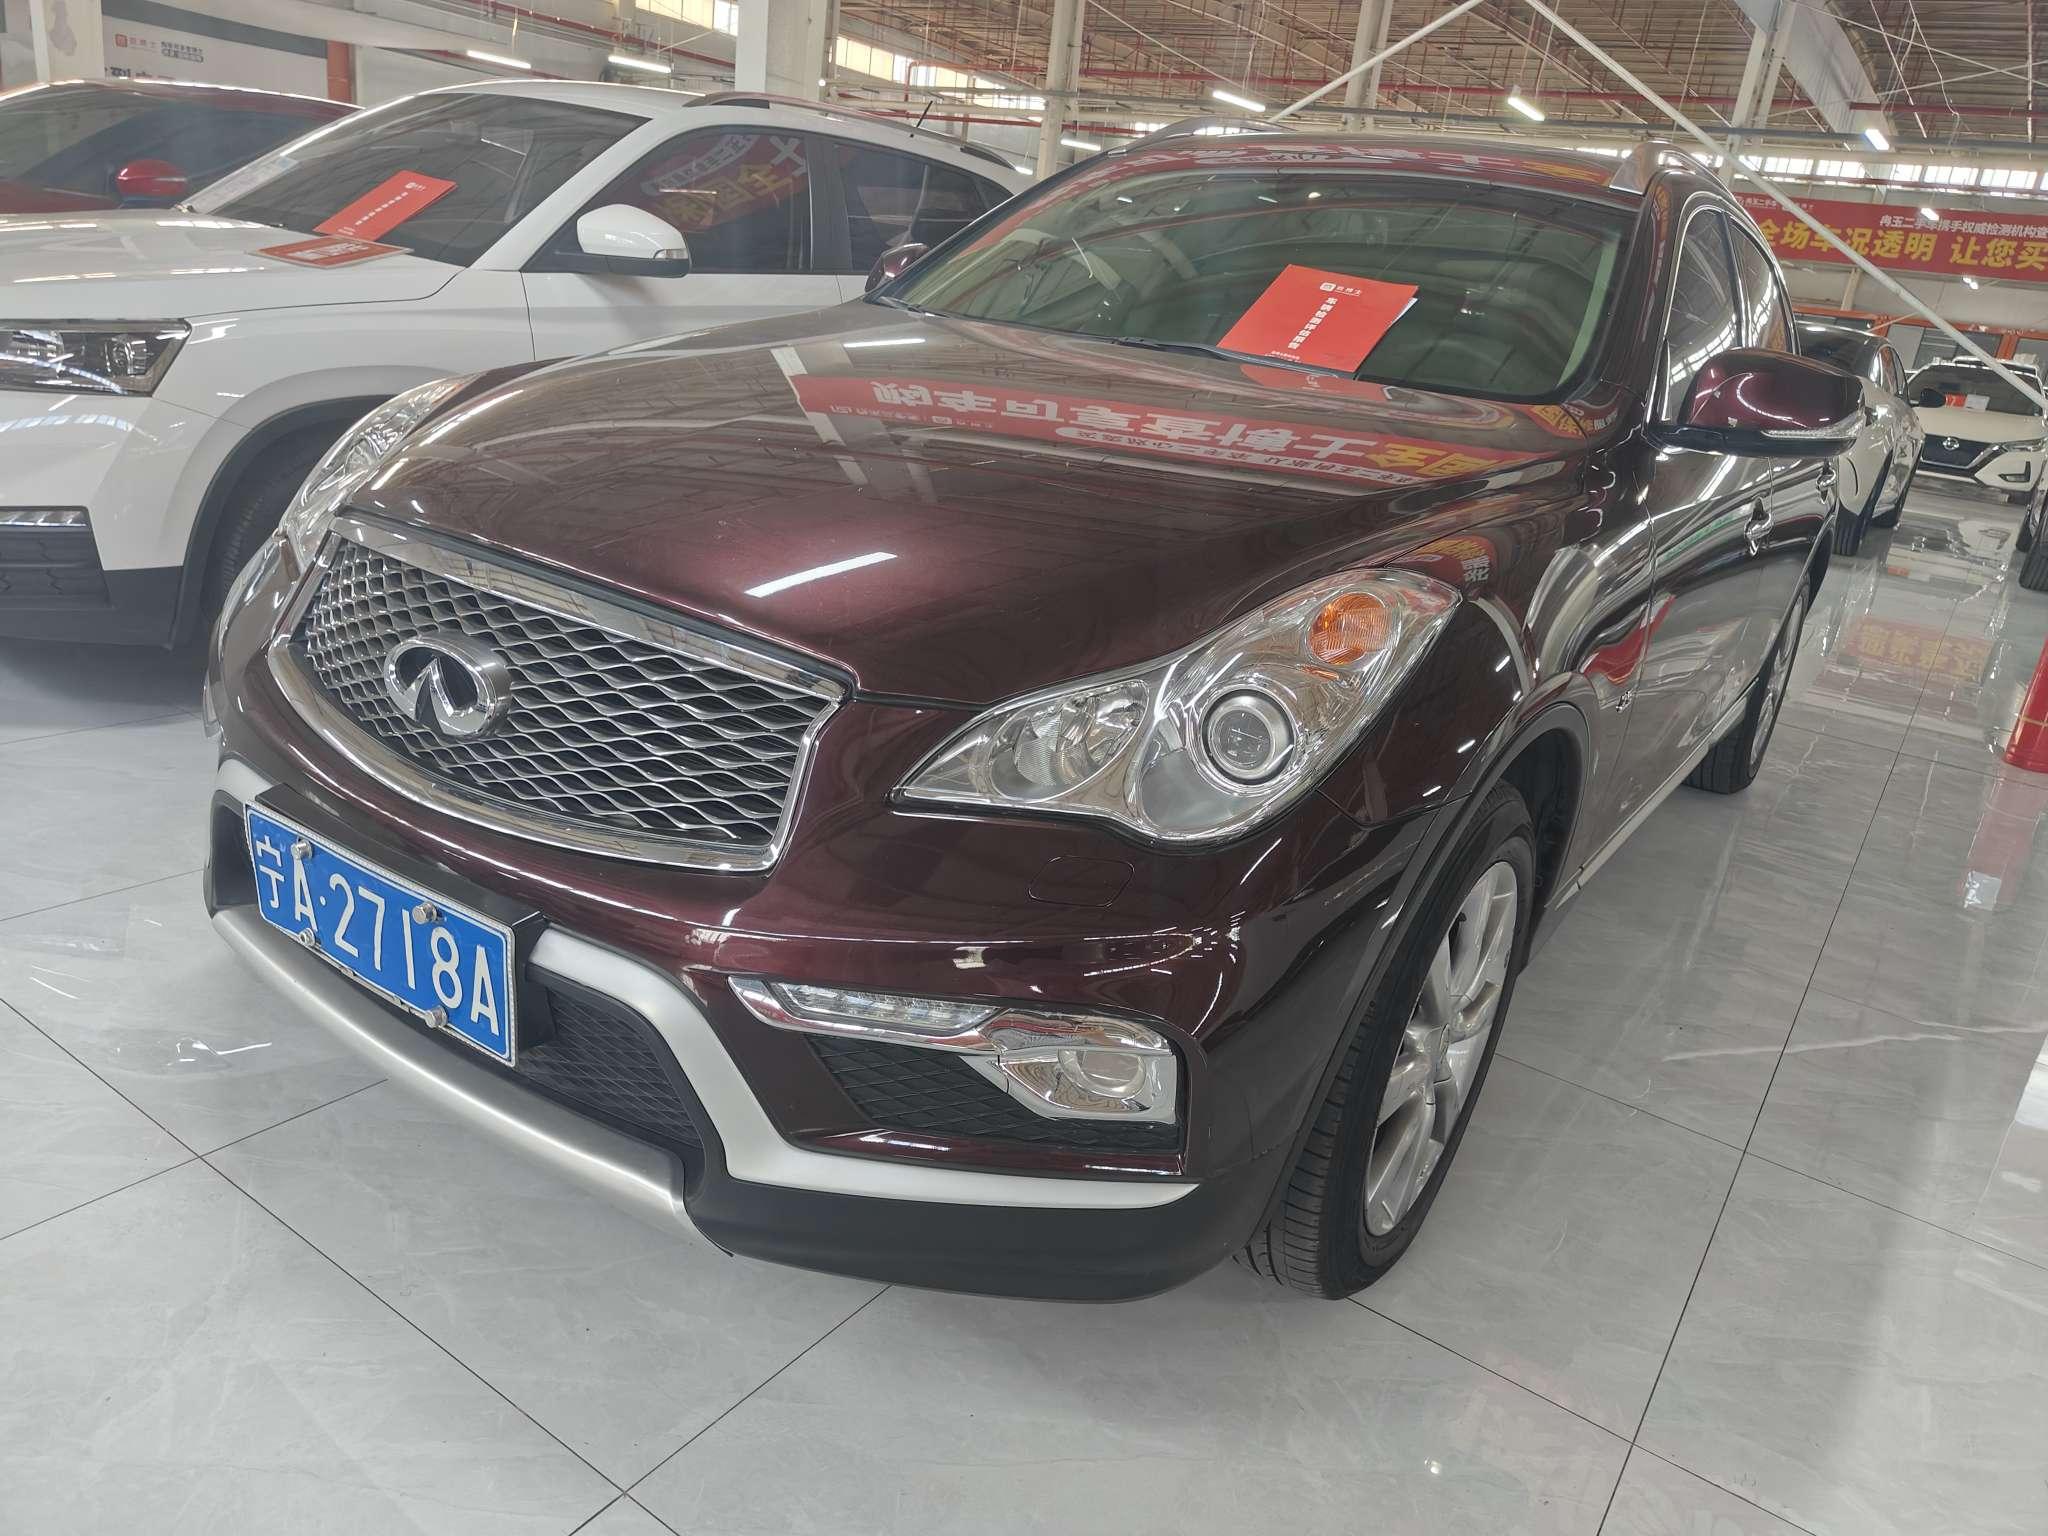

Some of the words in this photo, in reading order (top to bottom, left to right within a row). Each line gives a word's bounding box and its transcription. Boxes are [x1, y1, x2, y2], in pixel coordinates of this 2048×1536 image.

[1759, 217, 1938, 263] 全场车况透明
